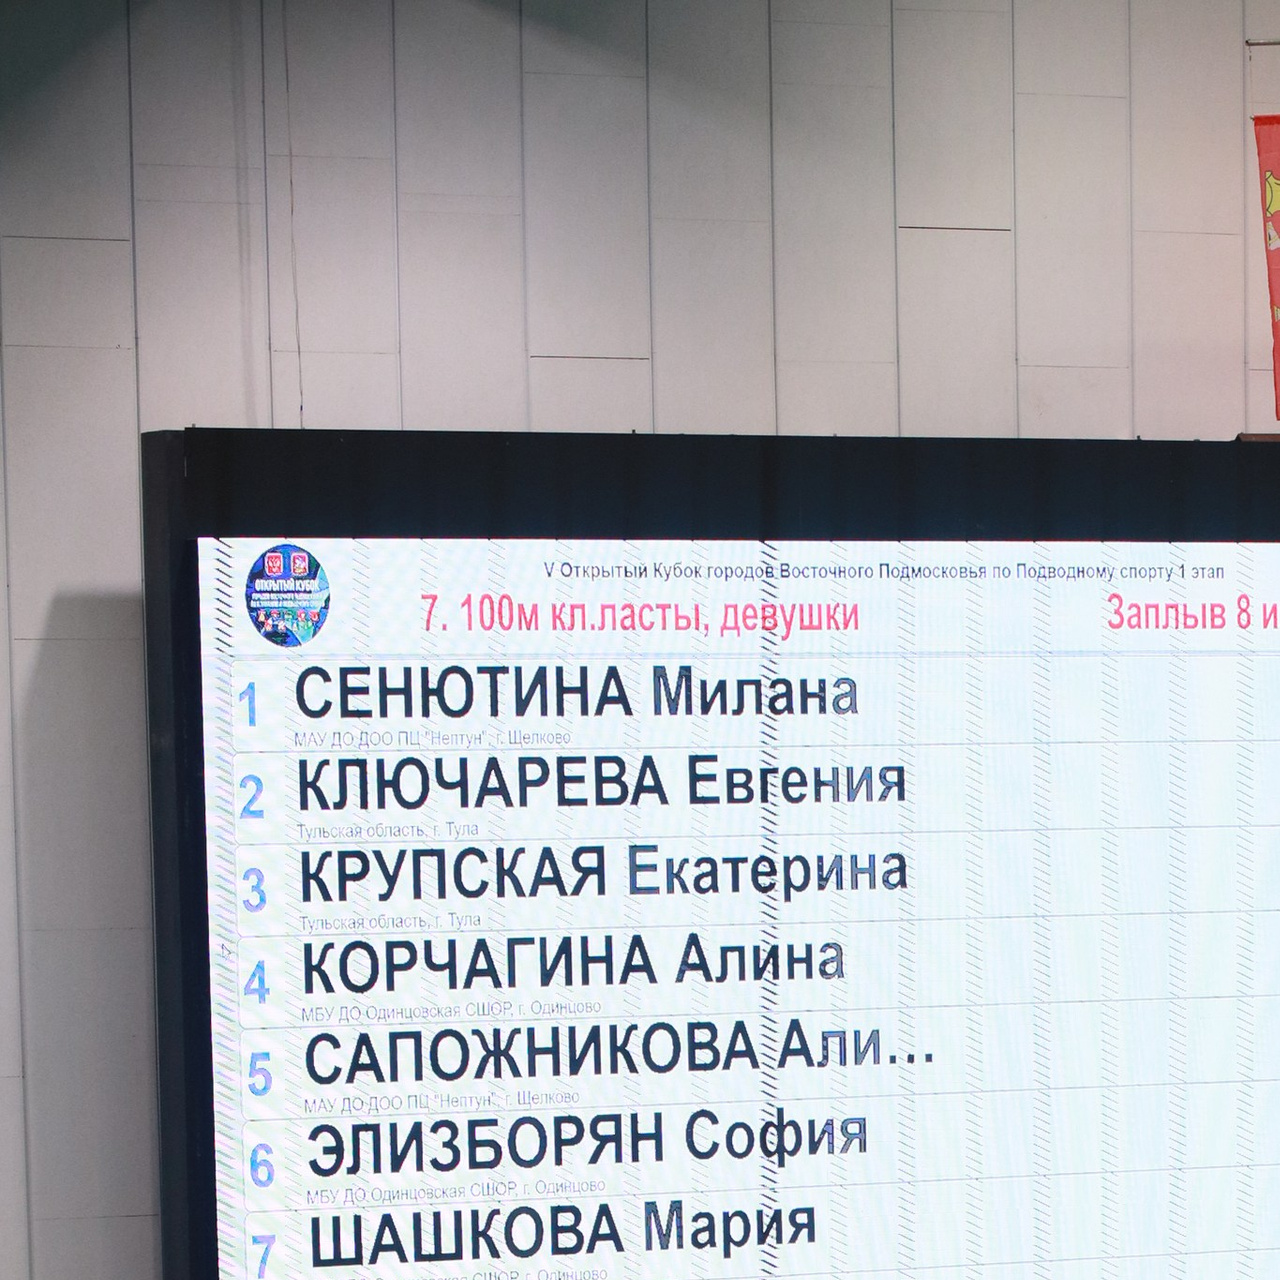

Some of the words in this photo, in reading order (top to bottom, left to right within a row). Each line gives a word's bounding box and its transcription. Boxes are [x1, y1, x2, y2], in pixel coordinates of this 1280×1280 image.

[560, 561, 648, 580] Открытый
[654, 562, 702, 581] Кубок
[707, 565, 775, 580] городов
[780, 563, 873, 579] Восточного
[879, 563, 987, 581] Подмосковья
[992, 566, 1011, 578] по
[1017, 563, 1115, 581] Подводному
[1120, 566, 1173, 581] спорту
[1179, 564, 1186, 578] 1
[1191, 567, 1224, 579] этап
[421, 594, 447, 631] 7.
[461, 593, 539, 631] 100м
[552, 602, 709, 636] кл.ласты,
[720, 603, 859, 641] девушки
[1107, 593, 1226, 629] Заплыв
[1237, 593, 1251, 629] 8
[238, 682, 257, 727] 1
[295, 665, 633, 718] СЕНЮТИНА
[653, 665, 859, 716] Милана
[295, 732, 327, 747] МАУ
[509, 730, 571, 747] Щелково
[239, 775, 264, 820] 2
[299, 755, 668, 810] КЛЮЧАРЕВА
[689, 754, 906, 805] Евгения
[297, 823, 362, 841] Тульская
[446, 821, 479, 839] Тула
[242, 868, 267, 913] 3
[301, 845, 605, 902] КРУПСКАЯ
[629, 844, 908, 902] Екатерина
[300, 915, 365, 933] Тульская
[448, 912, 481, 930] Тула
[244, 959, 271, 1004] 4
[303, 934, 658, 994] КОРЧАГИНА
[675, 932, 845, 983] Алина
[301, 1006, 335, 1022] МБУ
[366, 1004, 461, 1020] Одинцовская
[530, 1000, 602, 1016] Одинцово
[248, 1052, 272, 1096] 5
[305, 1020, 760, 1085] САПОЖНИКОВА
[304, 1098, 336, 1114] МАУ
[517, 1091, 580, 1107] Щелково
[250, 1143, 275, 1187] 6
[308, 1112, 664, 1177] ЭЛИЗБОРЯН
[686, 1108, 867, 1168] София
[307, 1189, 339, 1205] МБУ
[371, 1185, 466, 1202] Одинцовская
[535, 1179, 606, 1196] Одинцово
[251, 1235, 276, 1280] 7
[311, 1203, 625, 1268] ШАШКОВА
[644, 1200, 816, 1259] Мария
